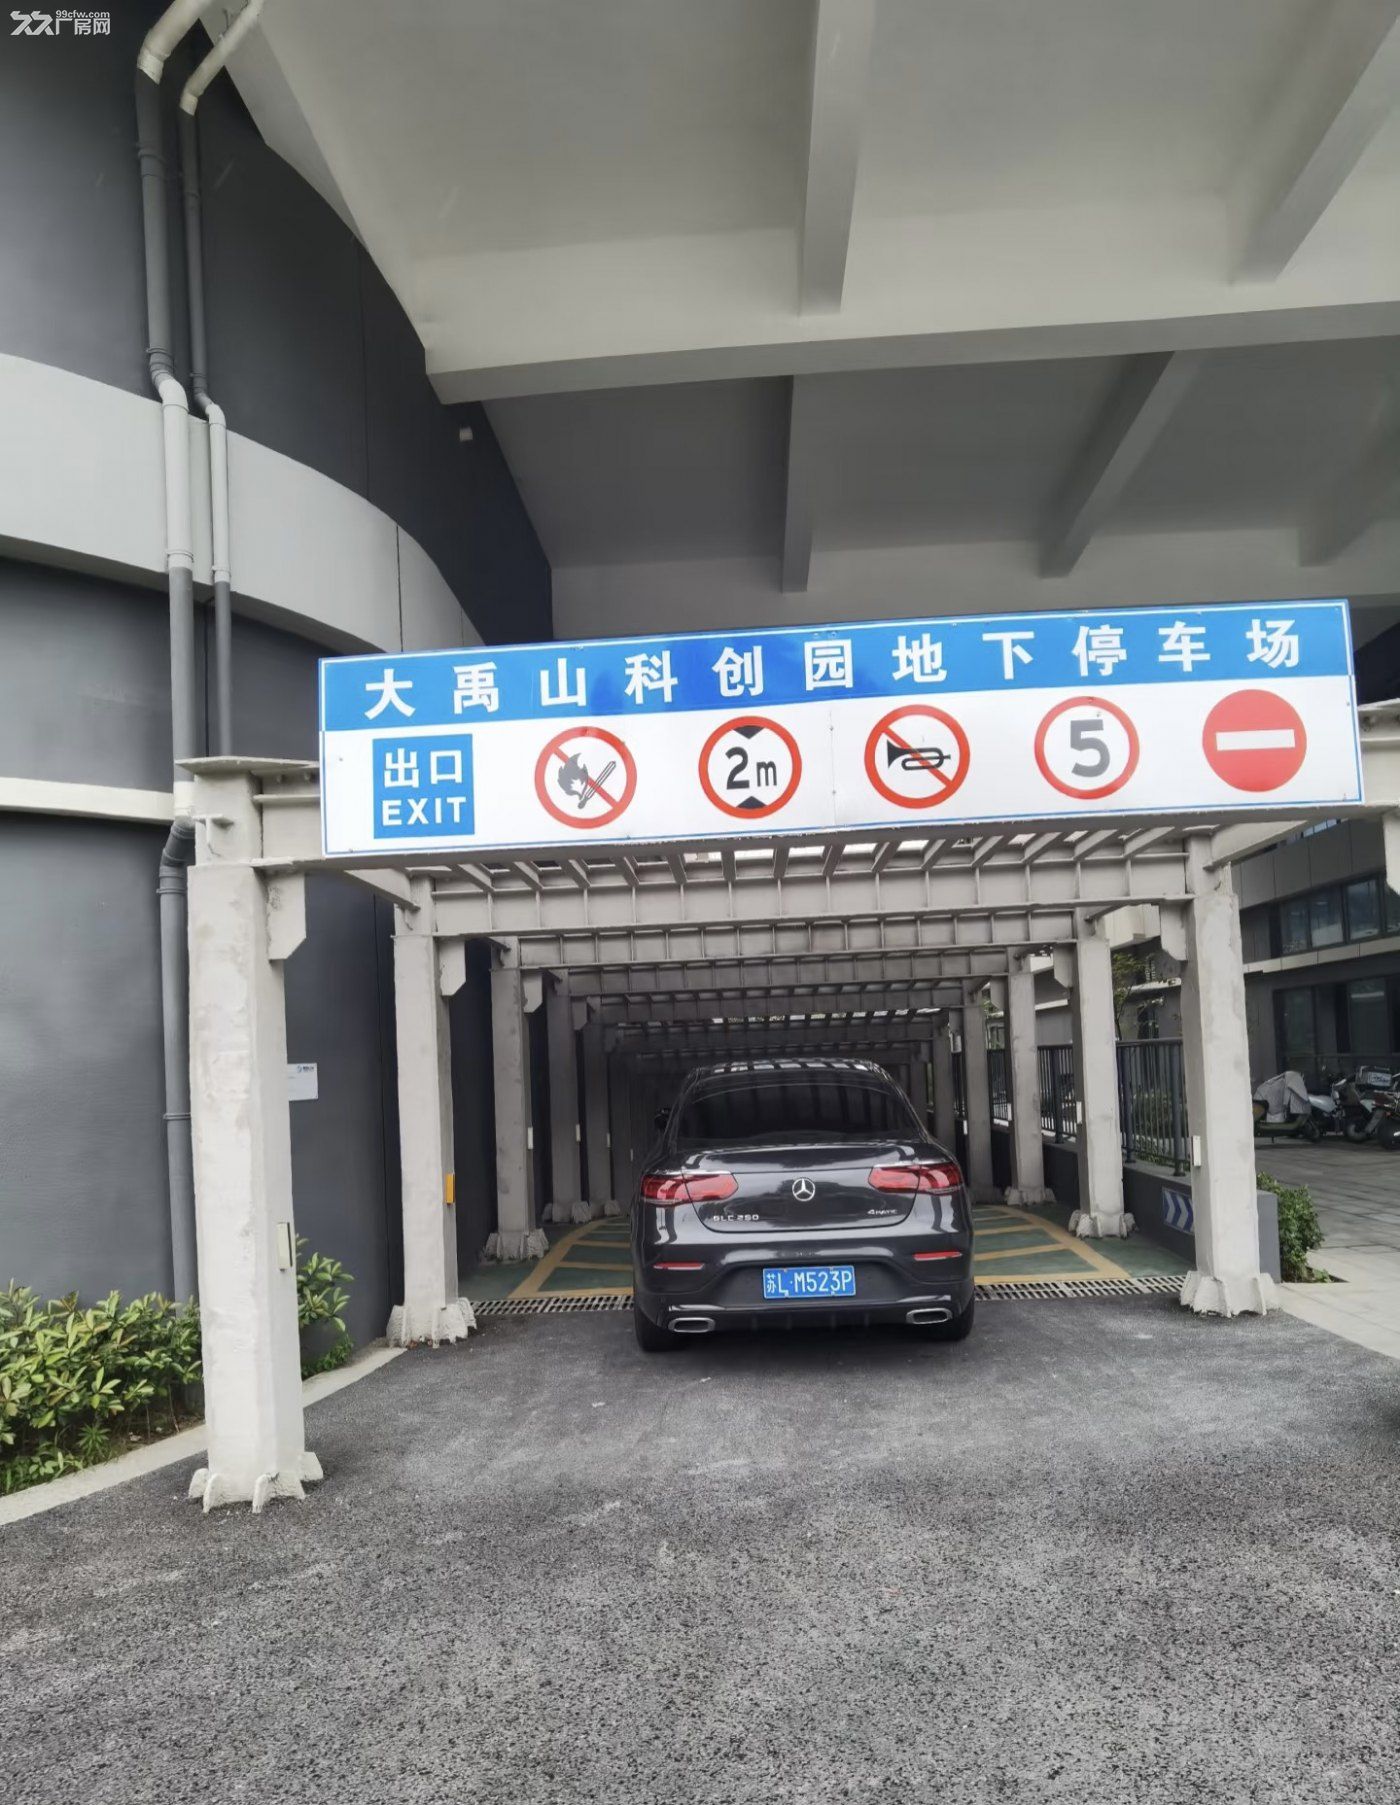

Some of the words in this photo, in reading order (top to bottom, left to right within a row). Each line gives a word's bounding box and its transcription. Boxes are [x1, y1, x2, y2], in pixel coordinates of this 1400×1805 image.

[364, 618, 1300, 720] 大禹山科创园地下停车场
[384, 748, 463, 788] 出口
[1070, 719, 1110, 778] 5
[382, 797, 467, 826] EXIT
